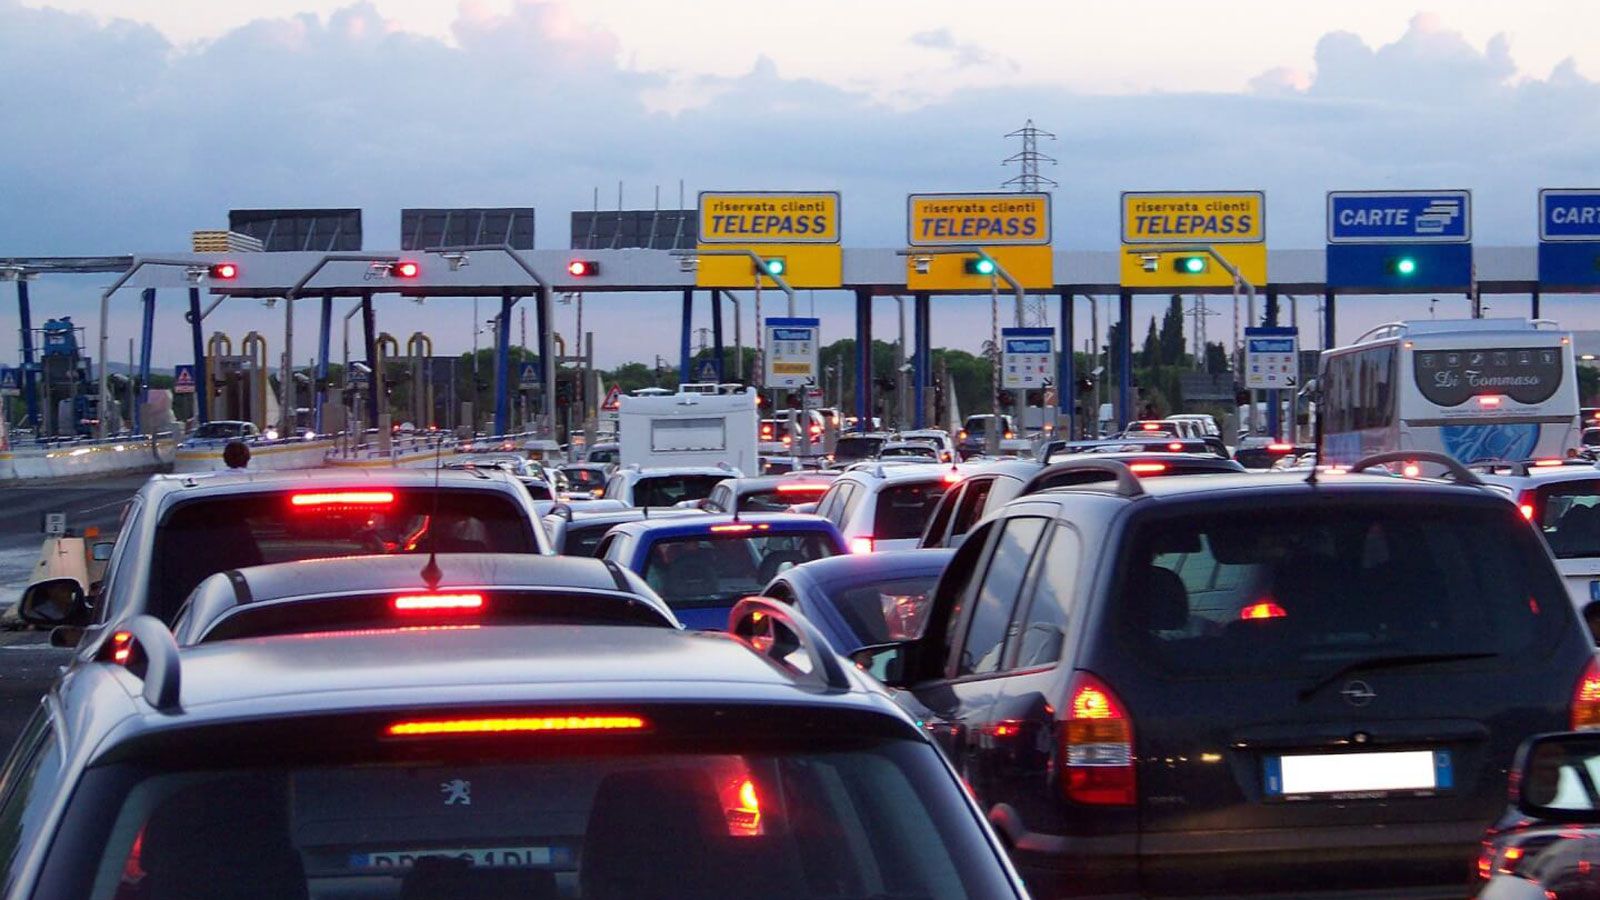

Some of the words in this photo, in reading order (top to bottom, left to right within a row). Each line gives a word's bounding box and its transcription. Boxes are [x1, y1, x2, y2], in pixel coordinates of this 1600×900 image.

[713, 201, 776, 212] riservata
[781, 201, 826, 212] clienti
[922, 203, 986, 214] riservata
[990, 202, 1036, 213] clienti
[1135, 201, 1199, 212] riservata
[1205, 201, 1251, 212] clienti
[712, 215, 827, 234] TELEPASS
[1134, 215, 1252, 234] TELEPASS
[1340, 208, 1410, 226] CARTE
[921, 217, 1037, 236] TELEPASS
[1464, 370, 1540, 388] Tommaso
